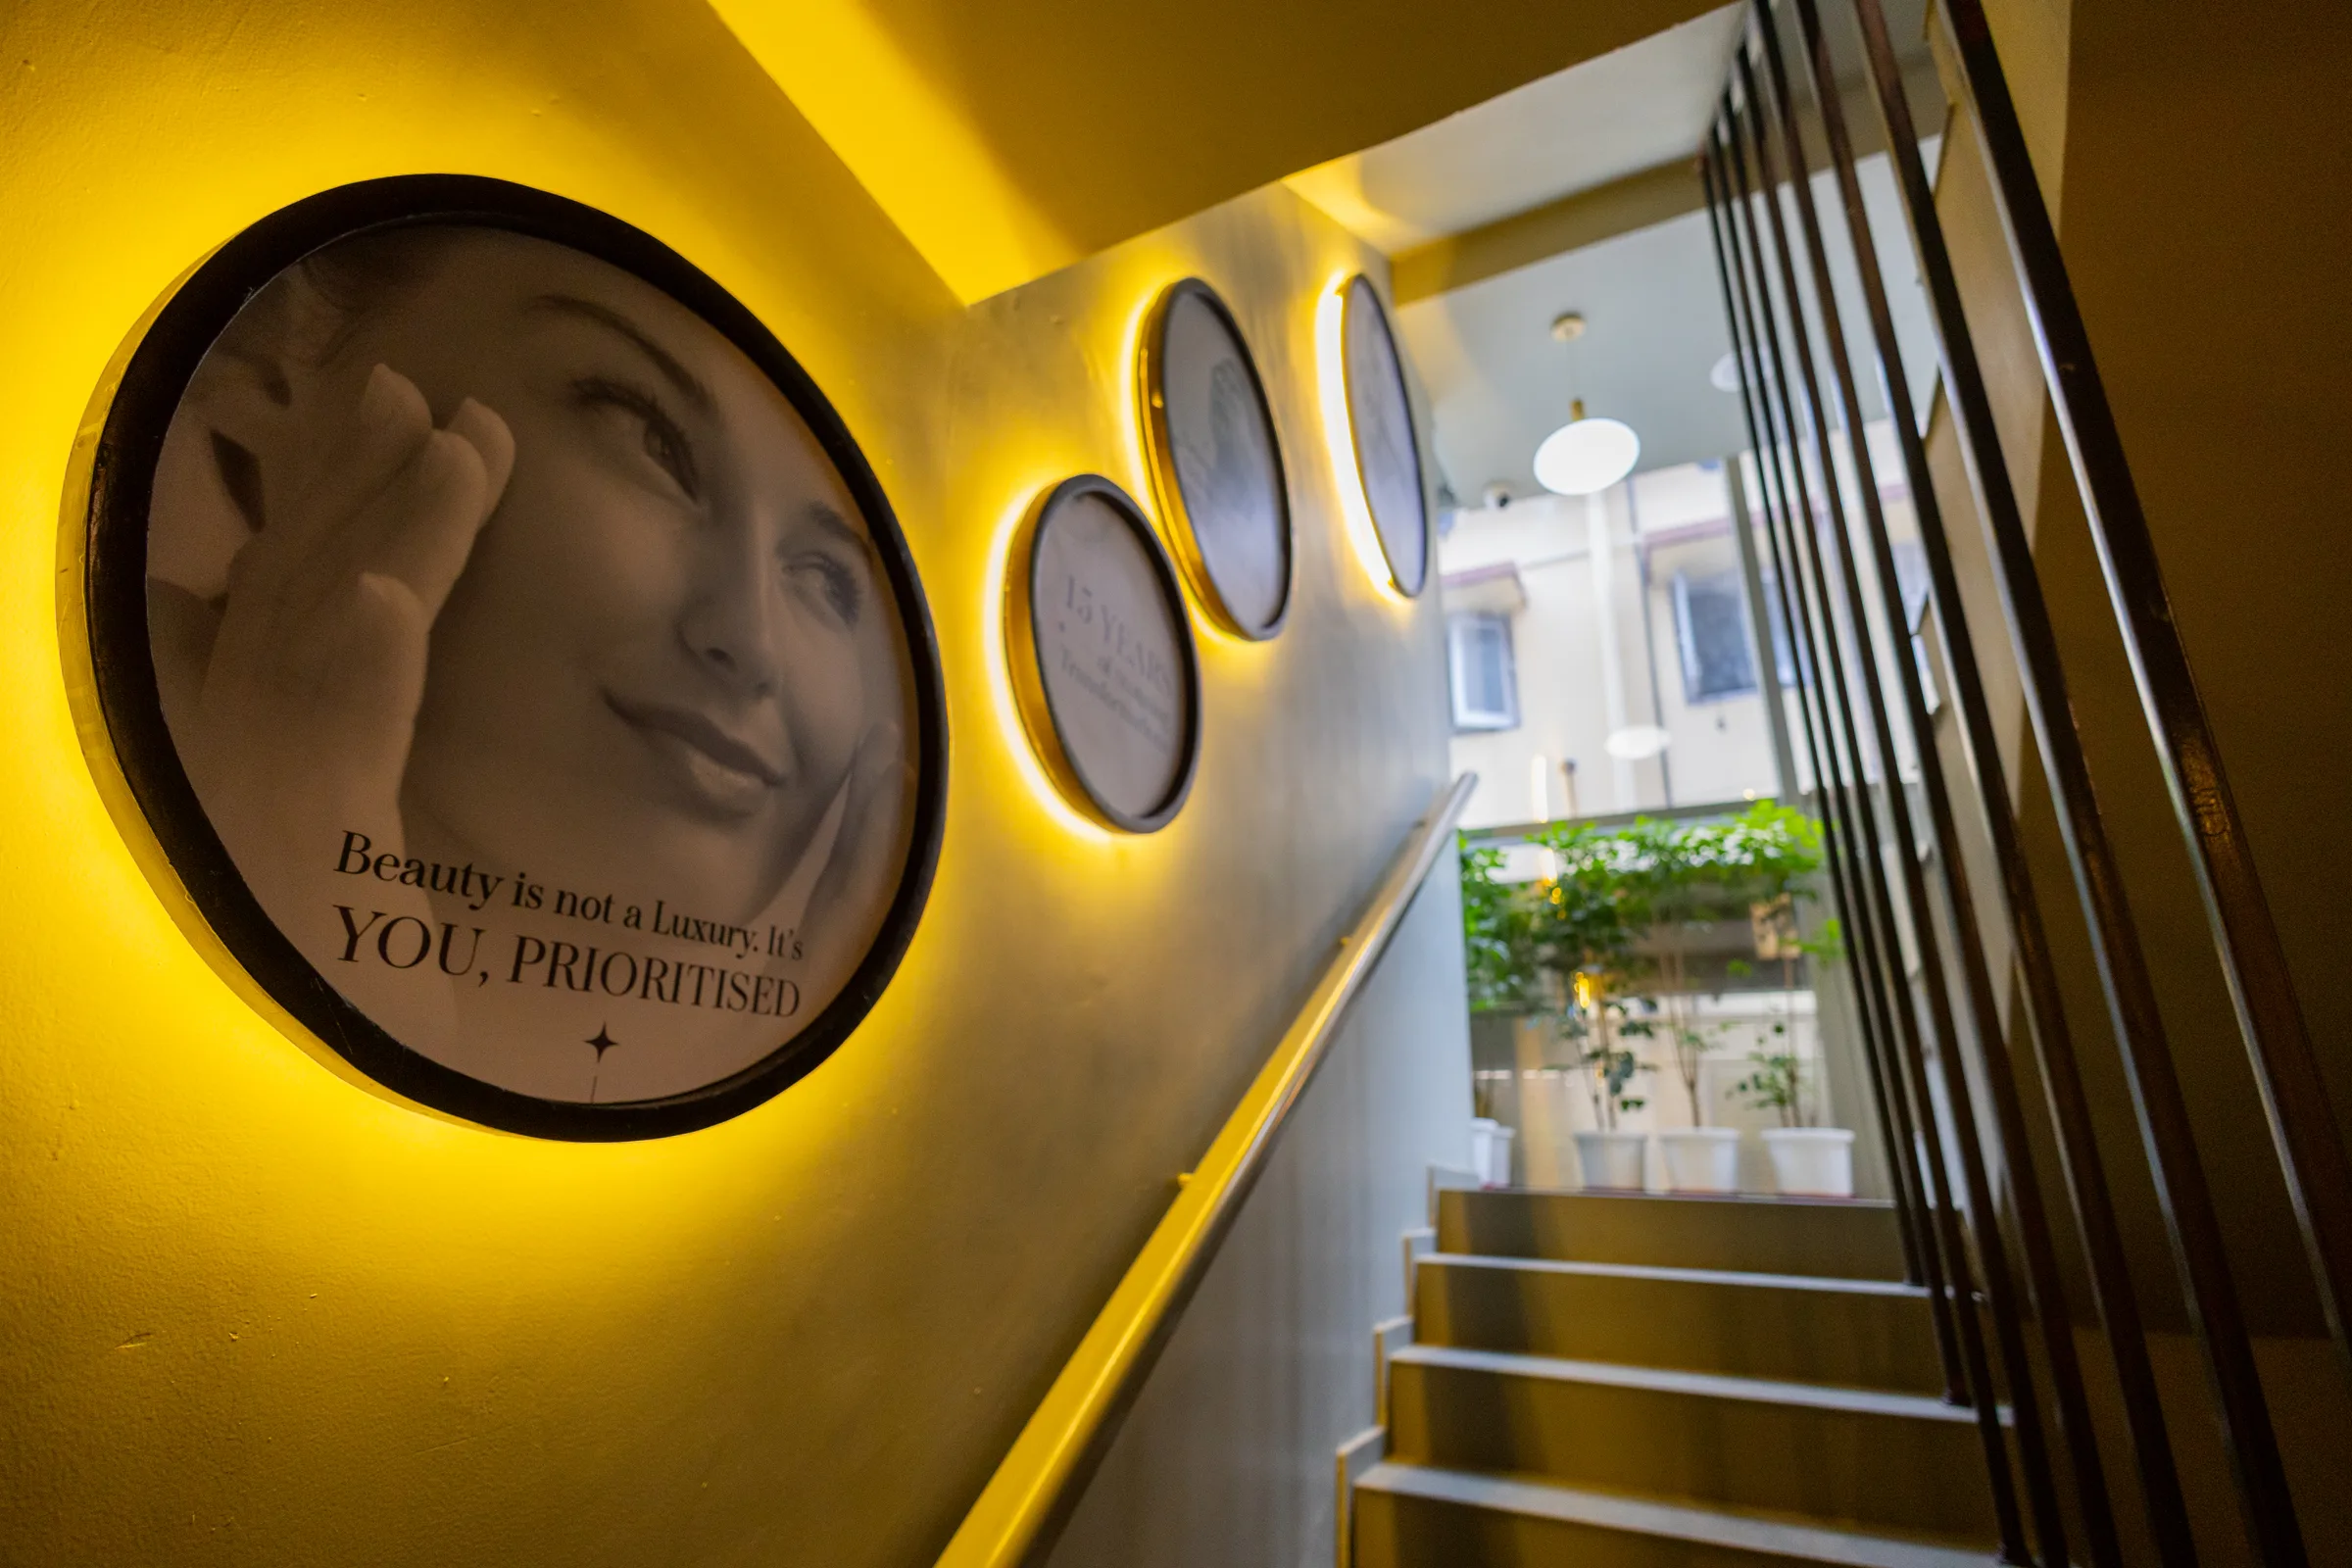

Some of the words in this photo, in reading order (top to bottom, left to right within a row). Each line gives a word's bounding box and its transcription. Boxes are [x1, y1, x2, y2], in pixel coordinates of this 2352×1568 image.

[1065, 574, 1094, 625] 15
[333, 830, 505, 910] Beauty
[512, 872, 544, 909] is
[554, 890, 615, 924] not
[623, 905, 642, 930] a
[652, 900, 759, 958] Luxury.
[766, 924, 804, 960] It's
[332, 905, 488, 987] YOU,
[506, 935, 800, 1017] PRIORITISED
